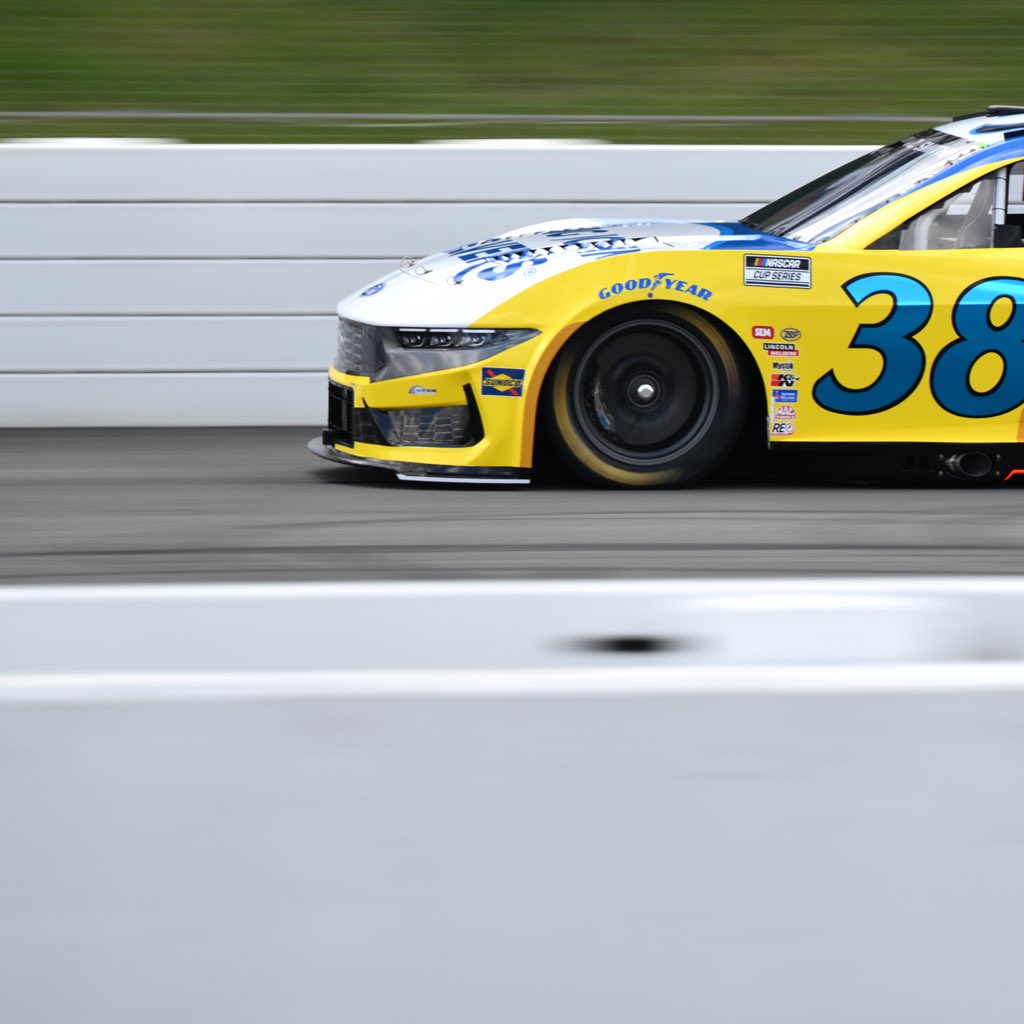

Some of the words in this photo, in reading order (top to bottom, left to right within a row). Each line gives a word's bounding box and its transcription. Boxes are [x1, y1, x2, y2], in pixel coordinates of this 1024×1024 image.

[767, 259, 801, 268] NASCAR
[754, 271, 771, 279] CUP
[772, 272, 802, 281] SERIES
[754, 328, 772, 337] SEM
[483, 378, 522, 387] SUNOCO
